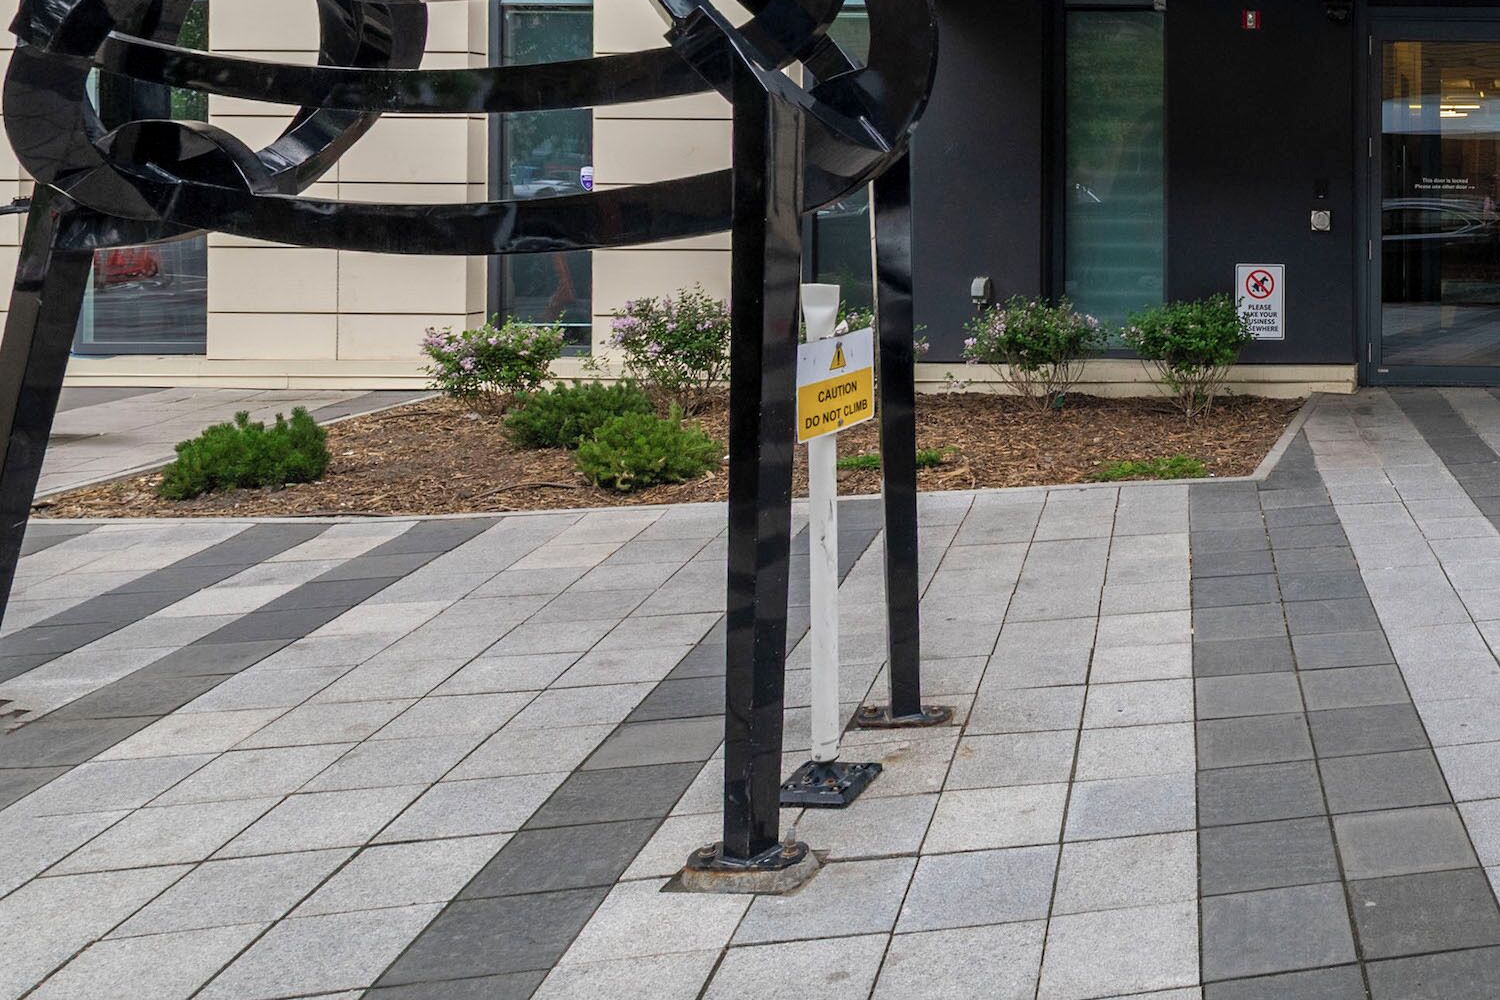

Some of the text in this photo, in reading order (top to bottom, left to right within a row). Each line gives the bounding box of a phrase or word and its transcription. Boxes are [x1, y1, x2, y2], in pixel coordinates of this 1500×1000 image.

[818, 380, 858, 403] CAUTION
[805, 399, 868, 430] DO NOT CLIMB
